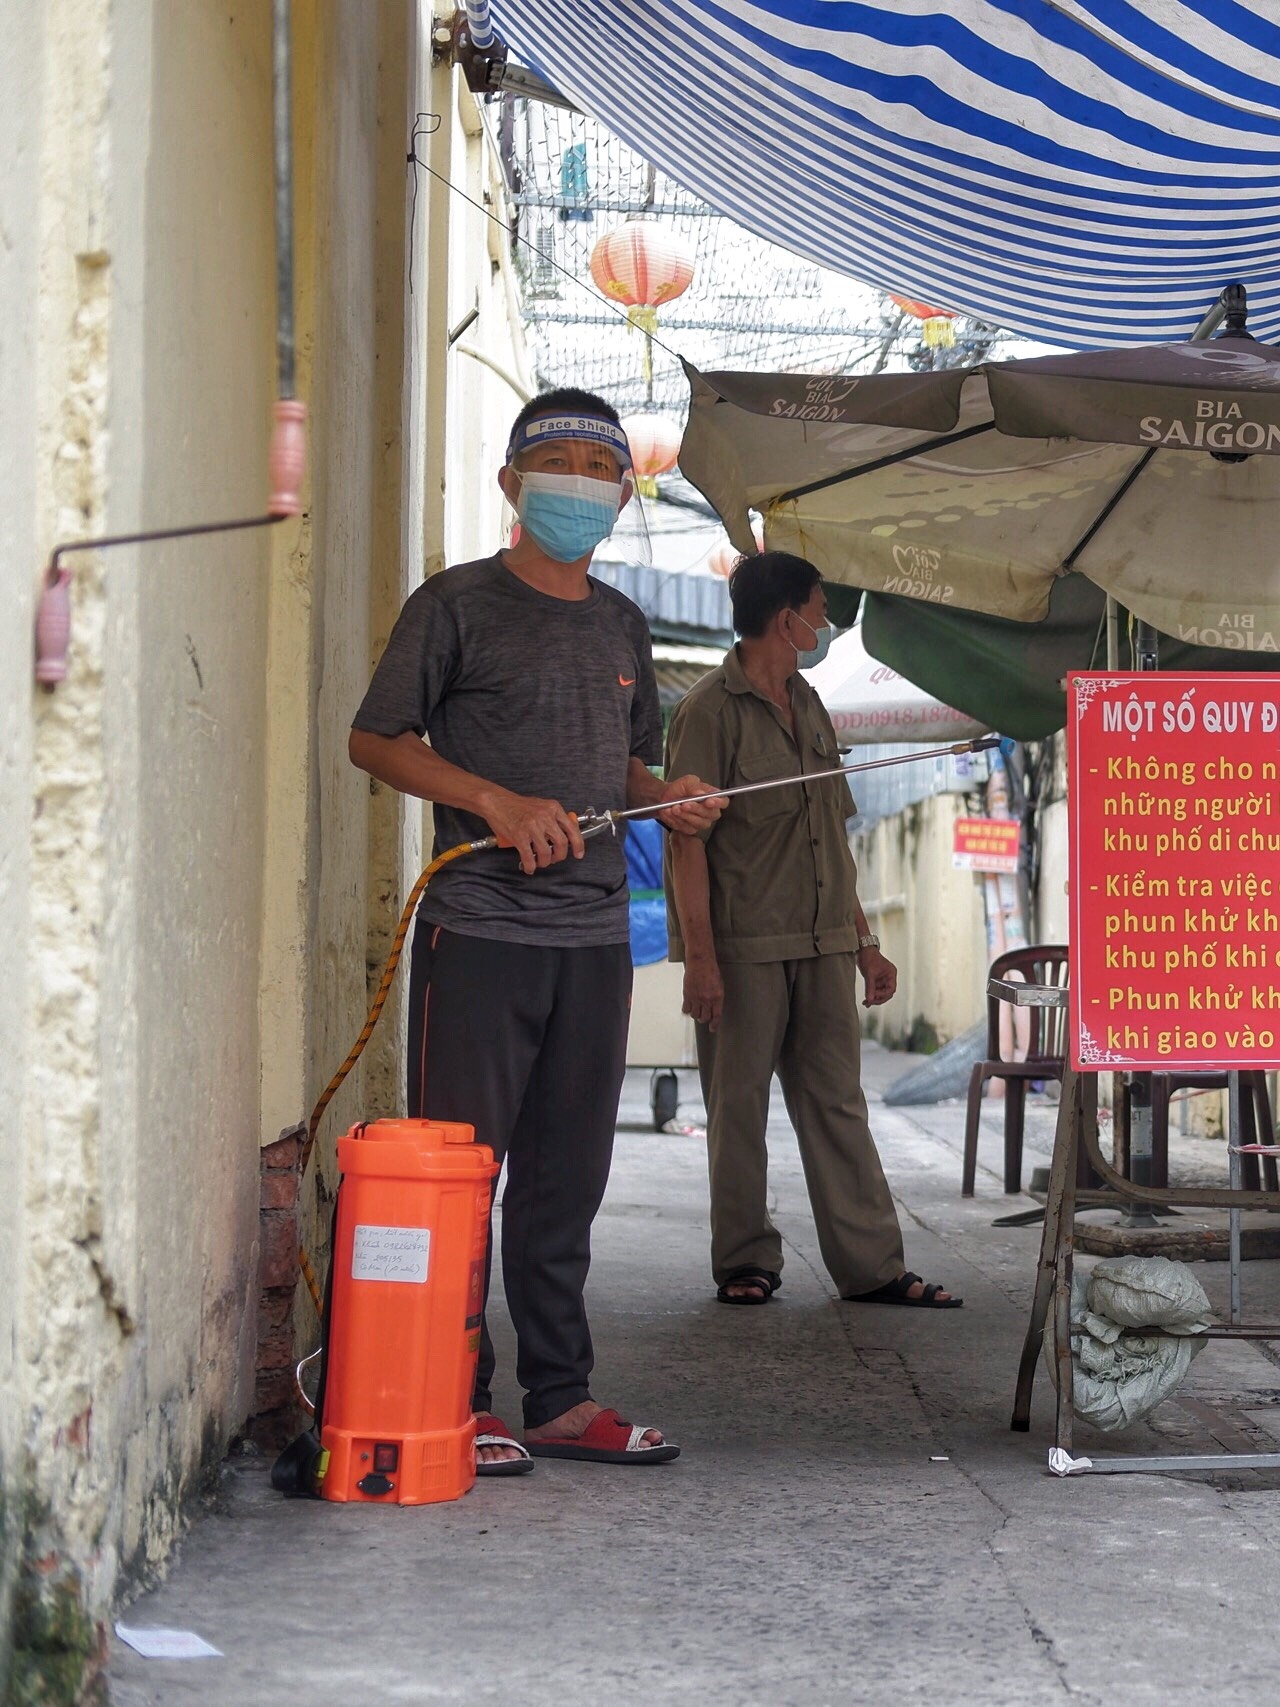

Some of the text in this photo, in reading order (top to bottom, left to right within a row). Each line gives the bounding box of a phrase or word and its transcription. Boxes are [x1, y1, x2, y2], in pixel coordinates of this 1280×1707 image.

[769, 398, 846, 421] SAIGON
[806, 391, 829, 403] BIA
[1196, 400, 1242, 419] BIA
[539, 420, 617, 437] Face Shield
[1104, 693, 1155, 741] MỘT
[1163, 688, 1195, 732] SỐ
[1203, 702, 1254, 732] QUY
[1108, 755, 1196, 786] Không
[1204, 756, 1253, 780] cho
[1104, 791, 1187, 821] những
[1194, 791, 1271, 821] người
[1104, 827, 1148, 852] khu
[1156, 824, 1203, 857] phố
[1209, 827, 1231, 852] di
[1106, 869, 1169, 897] Kiểm
[1176, 875, 1213, 897] tra
[1220, 872, 1272, 902] việc
[1105, 908, 1175, 938] phun
[1184, 906, 1239, 932] khử
[1106, 944, 1156, 969] khu
[1165, 941, 1218, 974] phố
[1225, 943, 1266, 968] khi
[1109, 986, 1179, 1010] Phun
[1189, 983, 1244, 1010] khử
[1107, 1025, 1149, 1050] khi
[1157, 1025, 1217, 1055] giao
[1224, 1024, 1274, 1049] vào
